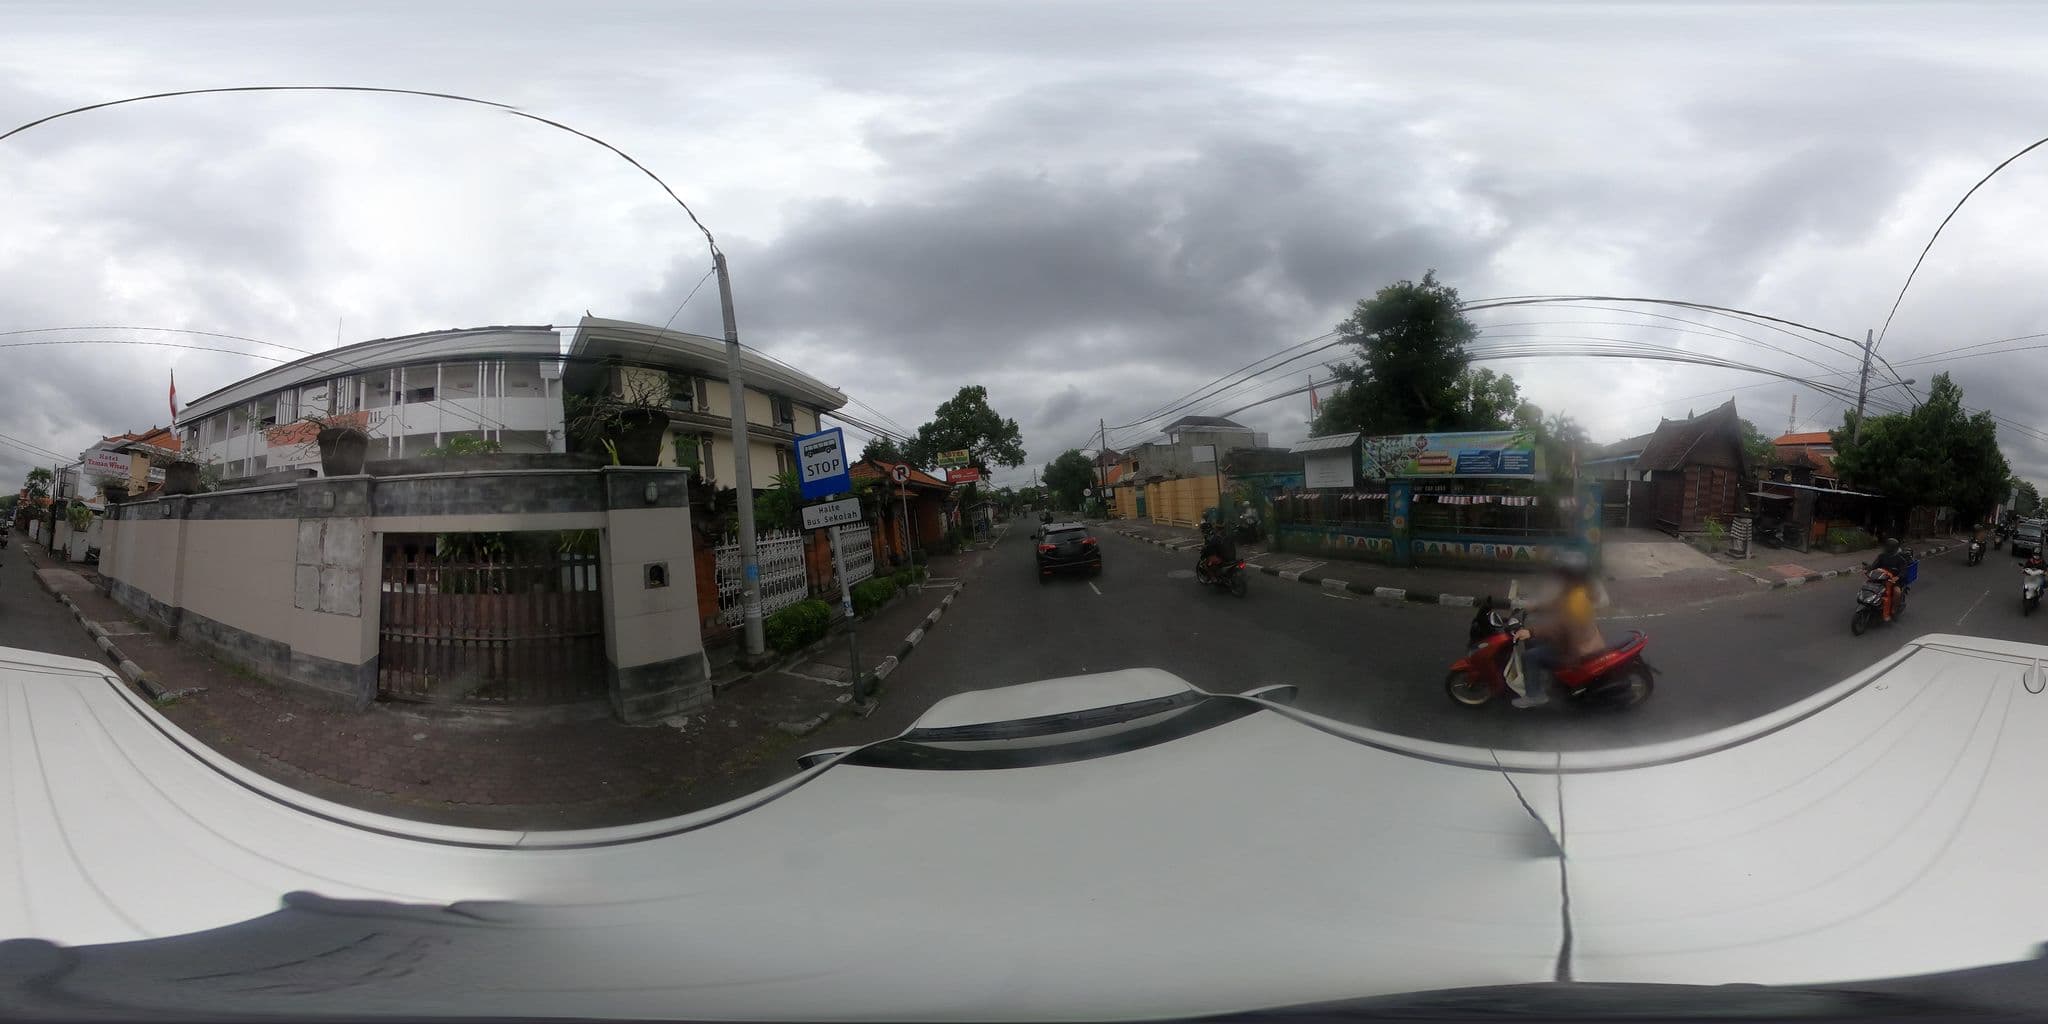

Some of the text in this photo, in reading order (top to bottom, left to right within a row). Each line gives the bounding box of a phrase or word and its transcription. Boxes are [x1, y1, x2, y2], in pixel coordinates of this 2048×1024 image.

[99, 453, 118, 461] Hotel
[88, 459, 108, 467] Taman
[807, 459, 840, 477] STOP
[818, 504, 840, 513] Halte
[807, 511, 858, 526] Bus Sekolah
